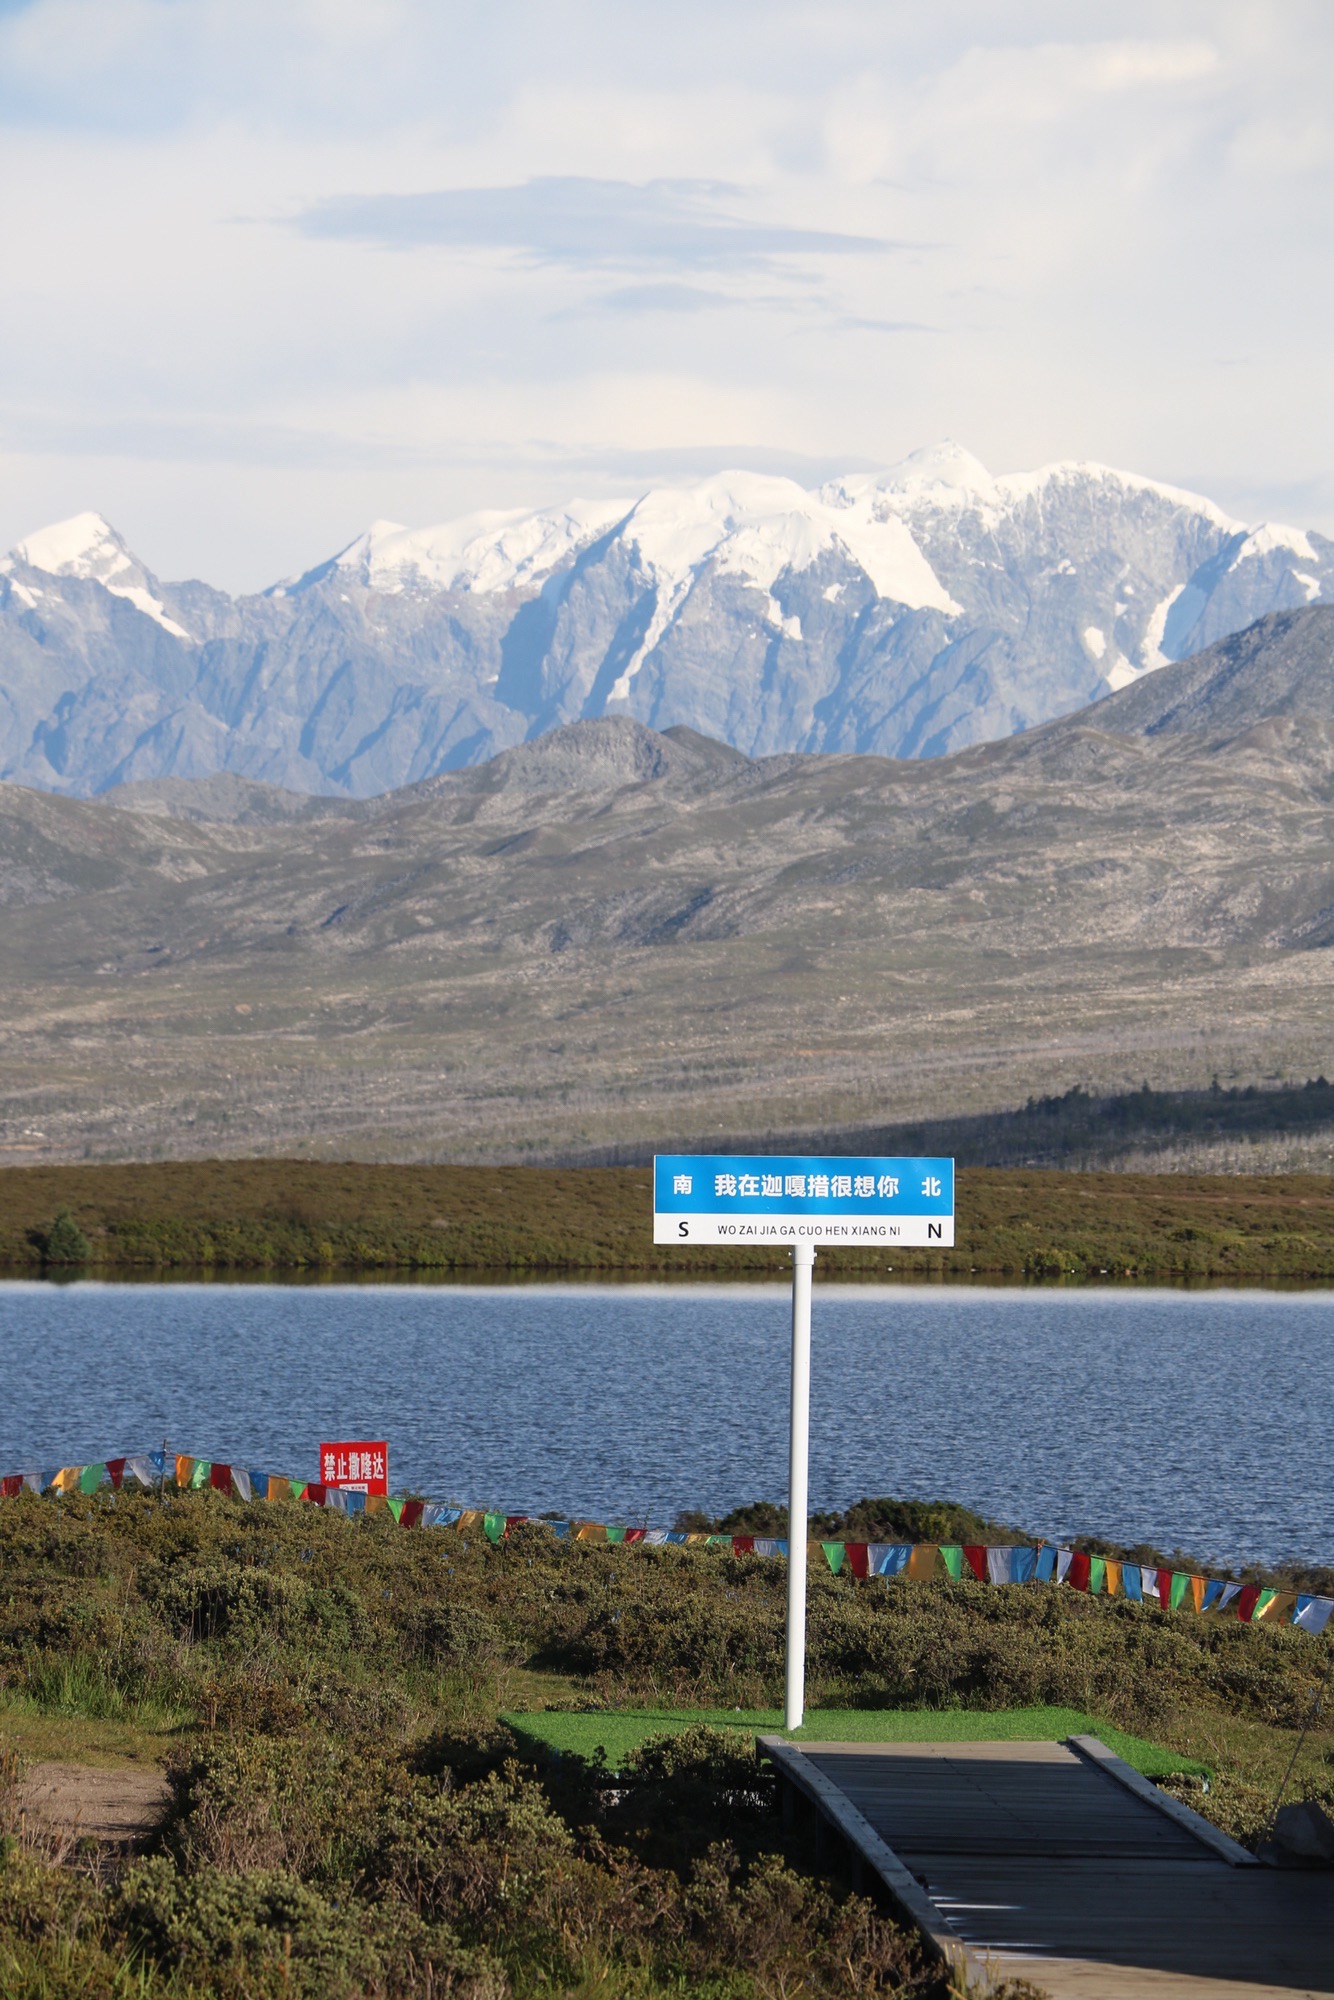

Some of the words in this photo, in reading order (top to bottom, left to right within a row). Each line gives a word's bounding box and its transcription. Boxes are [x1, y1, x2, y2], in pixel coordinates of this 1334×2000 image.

[673, 1174, 692, 1194] 南
[714, 1174, 899, 1197] 我在迦嘎措很想你
[921, 1176, 941, 1196] 北
[678, 1221, 689, 1237] S
[717, 1225, 737, 1235] WO
[739, 1225, 757, 1235] ZAI
[760, 1225, 778, 1236] JIA
[779, 1225, 796, 1236] GA
[798, 1225, 823, 1236] CUO
[825, 1225, 848, 1236] HEN
[851, 1226, 887, 1236] XIANG
[889, 1226, 901, 1236] NI
[928, 1223, 941, 1238] N
[324, 1451, 384, 1481] 禁止撒隆达
